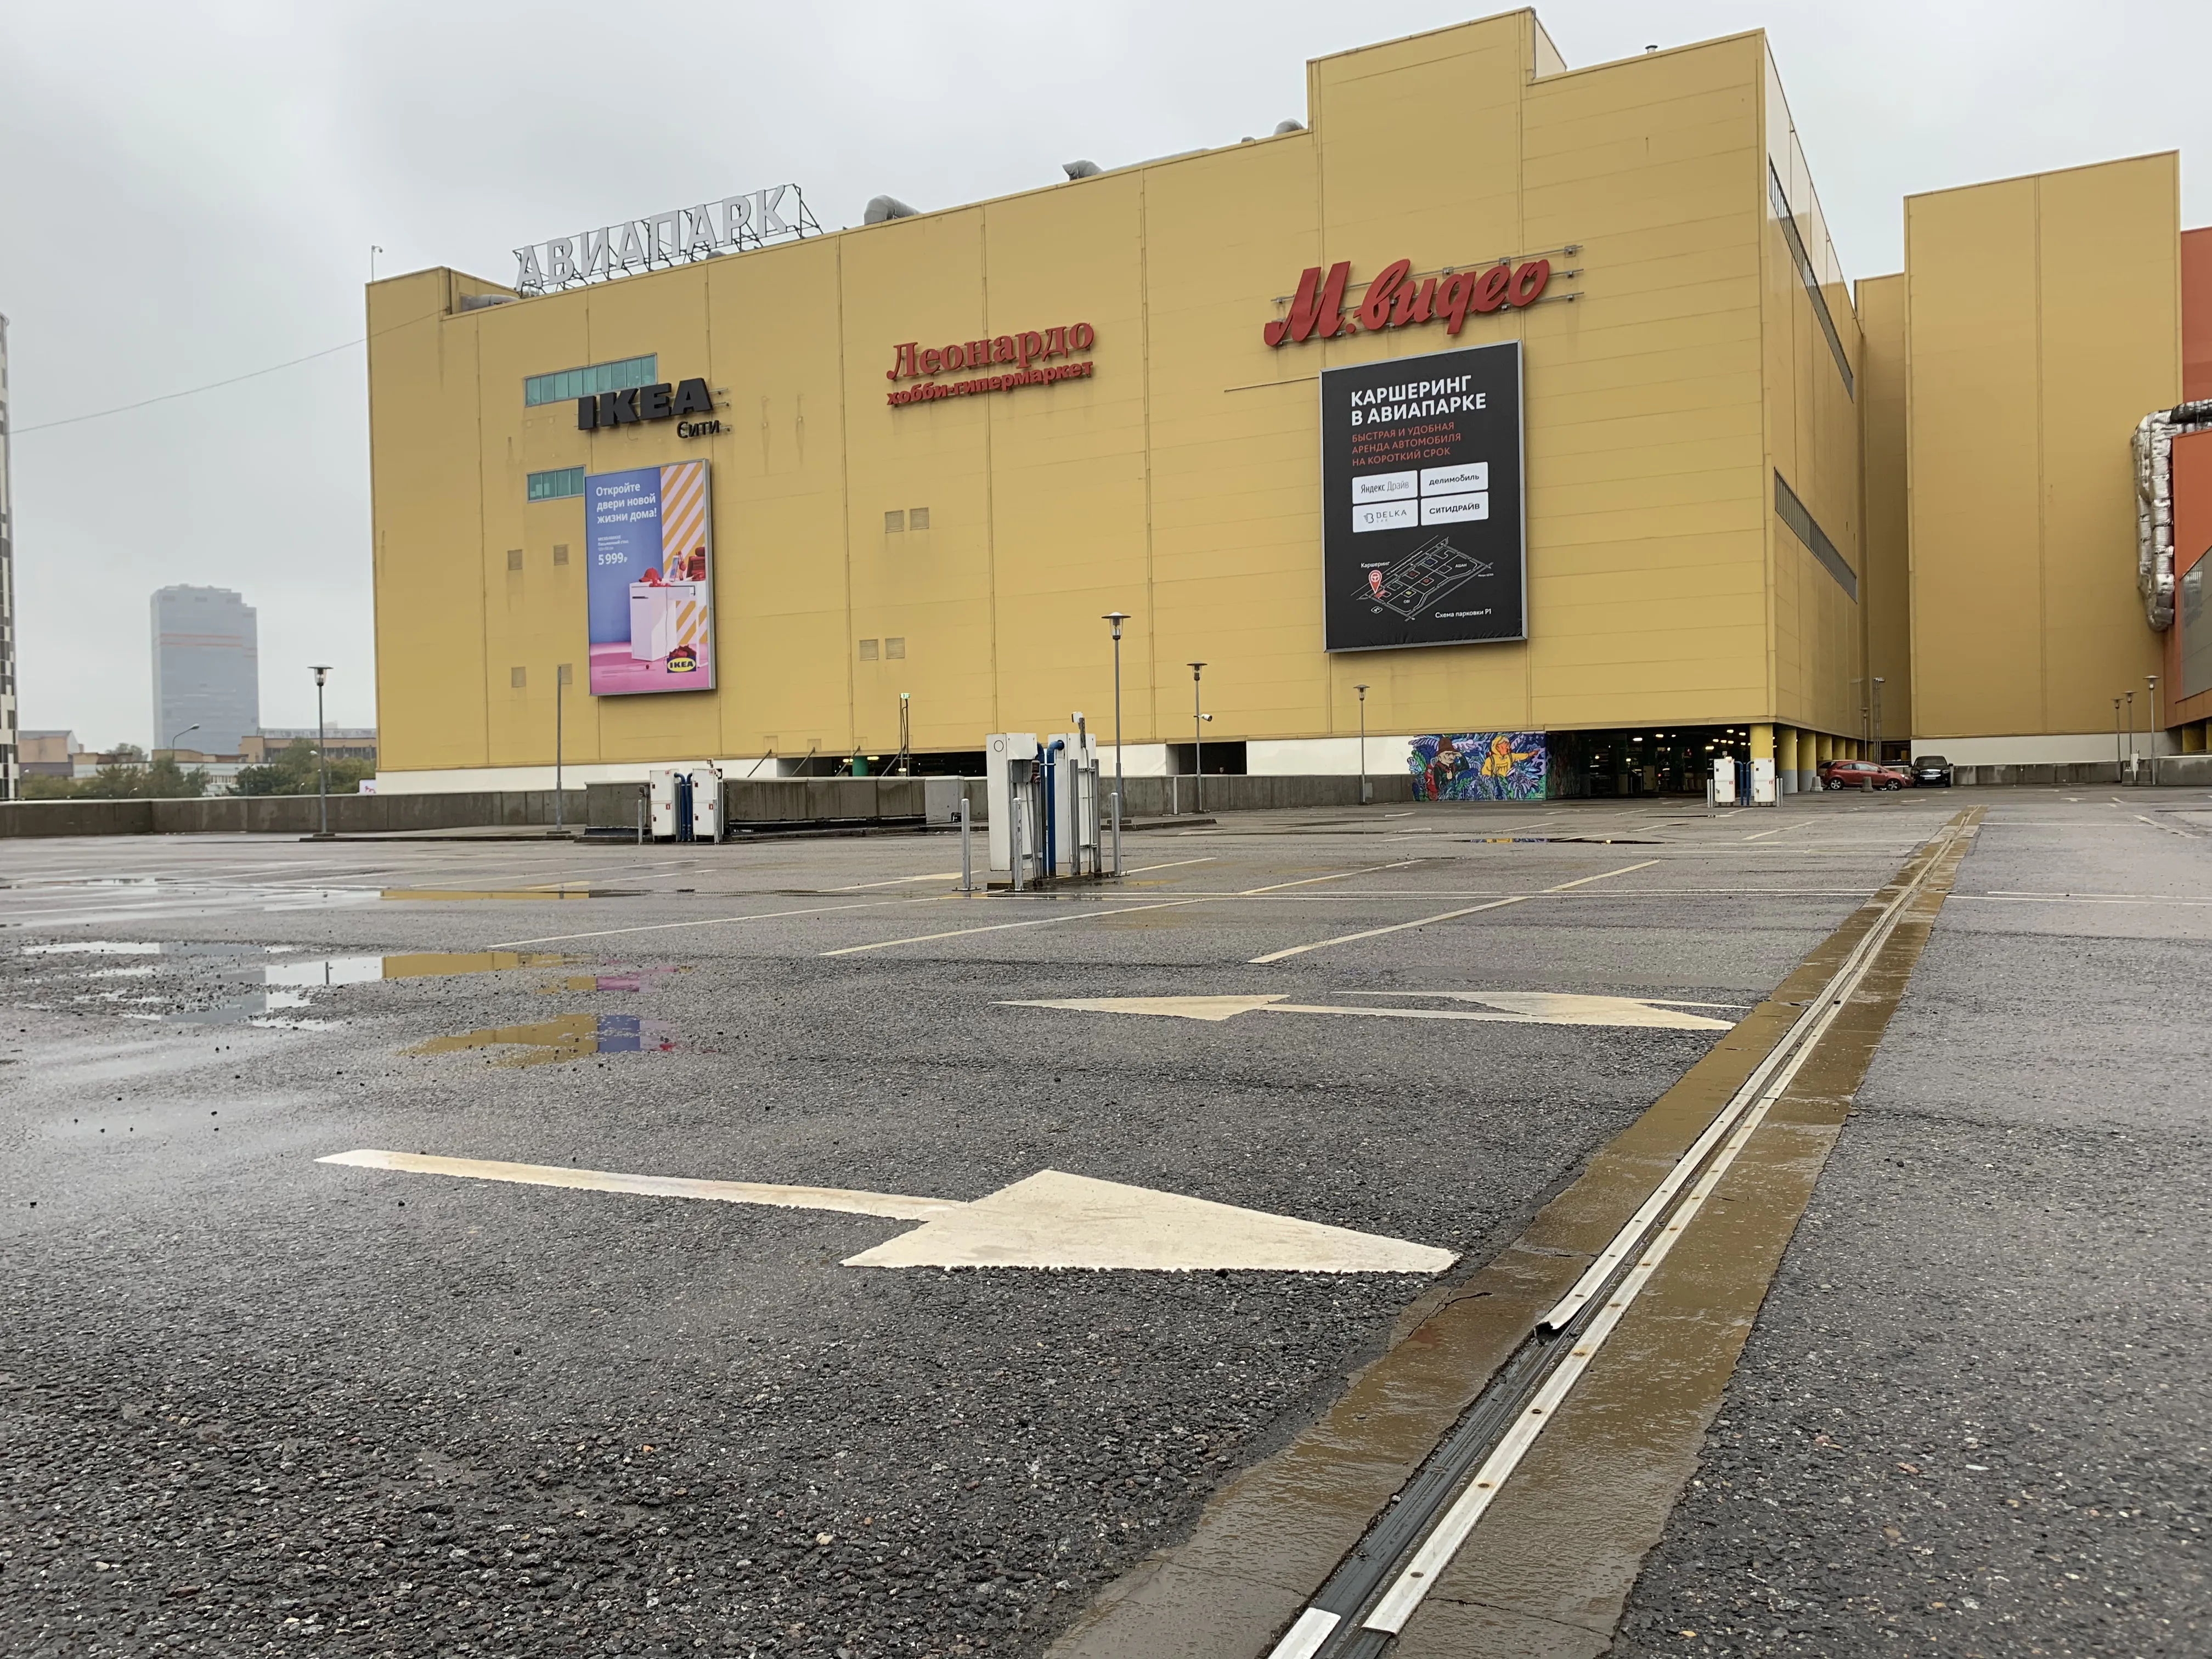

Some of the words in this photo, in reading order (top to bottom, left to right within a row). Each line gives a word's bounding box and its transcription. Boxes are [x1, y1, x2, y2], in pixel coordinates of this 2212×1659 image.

[516, 184, 788, 291] АВИАПАРК
[886, 322, 1094, 380] Леонардо
[887, 361, 1093, 406] хобби-гипермаркет
[1351, 375, 1472, 407] КАРШЕРИНГ
[578, 377, 714, 430] IKEA
[1351, 410, 1363, 426] В
[1367, 393, 1486, 424] АВИАПАРКЕ
[676, 420, 720, 438] Сити
[1352, 430, 1396, 443] БЫСТРАЯ
[1398, 428, 1405, 437] И
[1408, 421, 1454, 436] УДОБНАЯ
[1352, 443, 1390, 454] АРЕНДА
[1392, 433, 1461, 449] АВТОМОБИЛЯ
[1352, 457, 1365, 466] НА
[1368, 449, 1421, 465] КОРОТКИЙ
[1424, 447, 1451, 458] СРОК
[596, 482, 641, 497] Откройте
[1361, 483, 1386, 494] Яндекс
[1387, 480, 1409, 492] Драйв
[1429, 474, 1480, 486] делимобиль
[596, 499, 625, 512] двери
[627, 493, 656, 506] новой
[1429, 503, 1480, 515] СИТИДРАЙВ
[597, 513, 628, 524] жизни
[630, 507, 657, 522] дома!
[1376, 509, 1407, 519] BELKA
